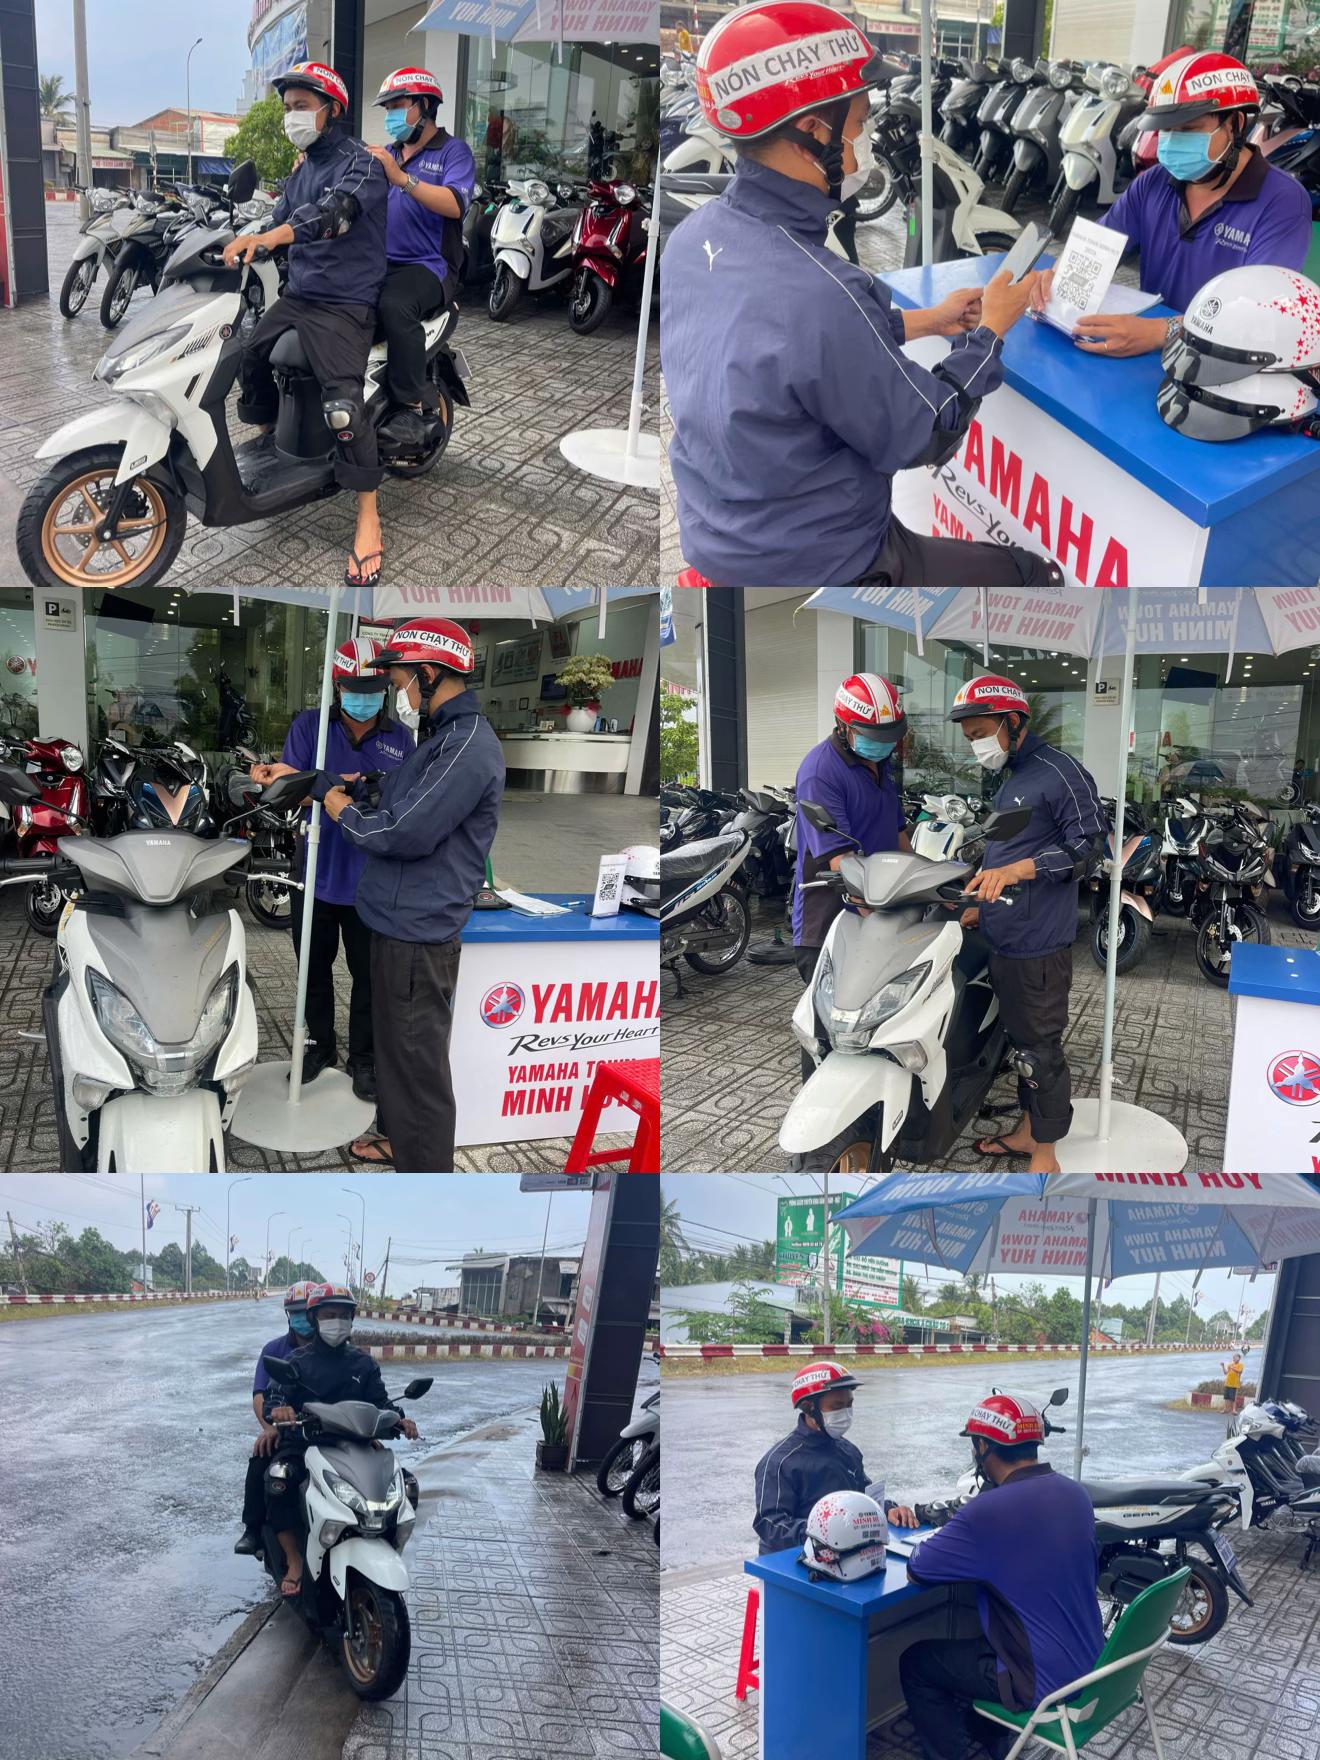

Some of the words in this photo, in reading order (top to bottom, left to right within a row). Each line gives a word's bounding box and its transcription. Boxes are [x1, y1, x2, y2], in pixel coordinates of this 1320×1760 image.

[714, 65, 761, 100] NÓN
[764, 43, 819, 76] CHẠY
[1191, 73, 1223, 90] NÓN
[952, 417, 1129, 587] AMAHA
[531, 980, 660, 1024] YAMAH
[507, 1033, 572, 1057] Revs
[570, 1031, 615, 1051] Your
[613, 1026, 659, 1041] Heart
[508, 1061, 579, 1084] YAMAHA
[501, 1086, 573, 1117] MINH
